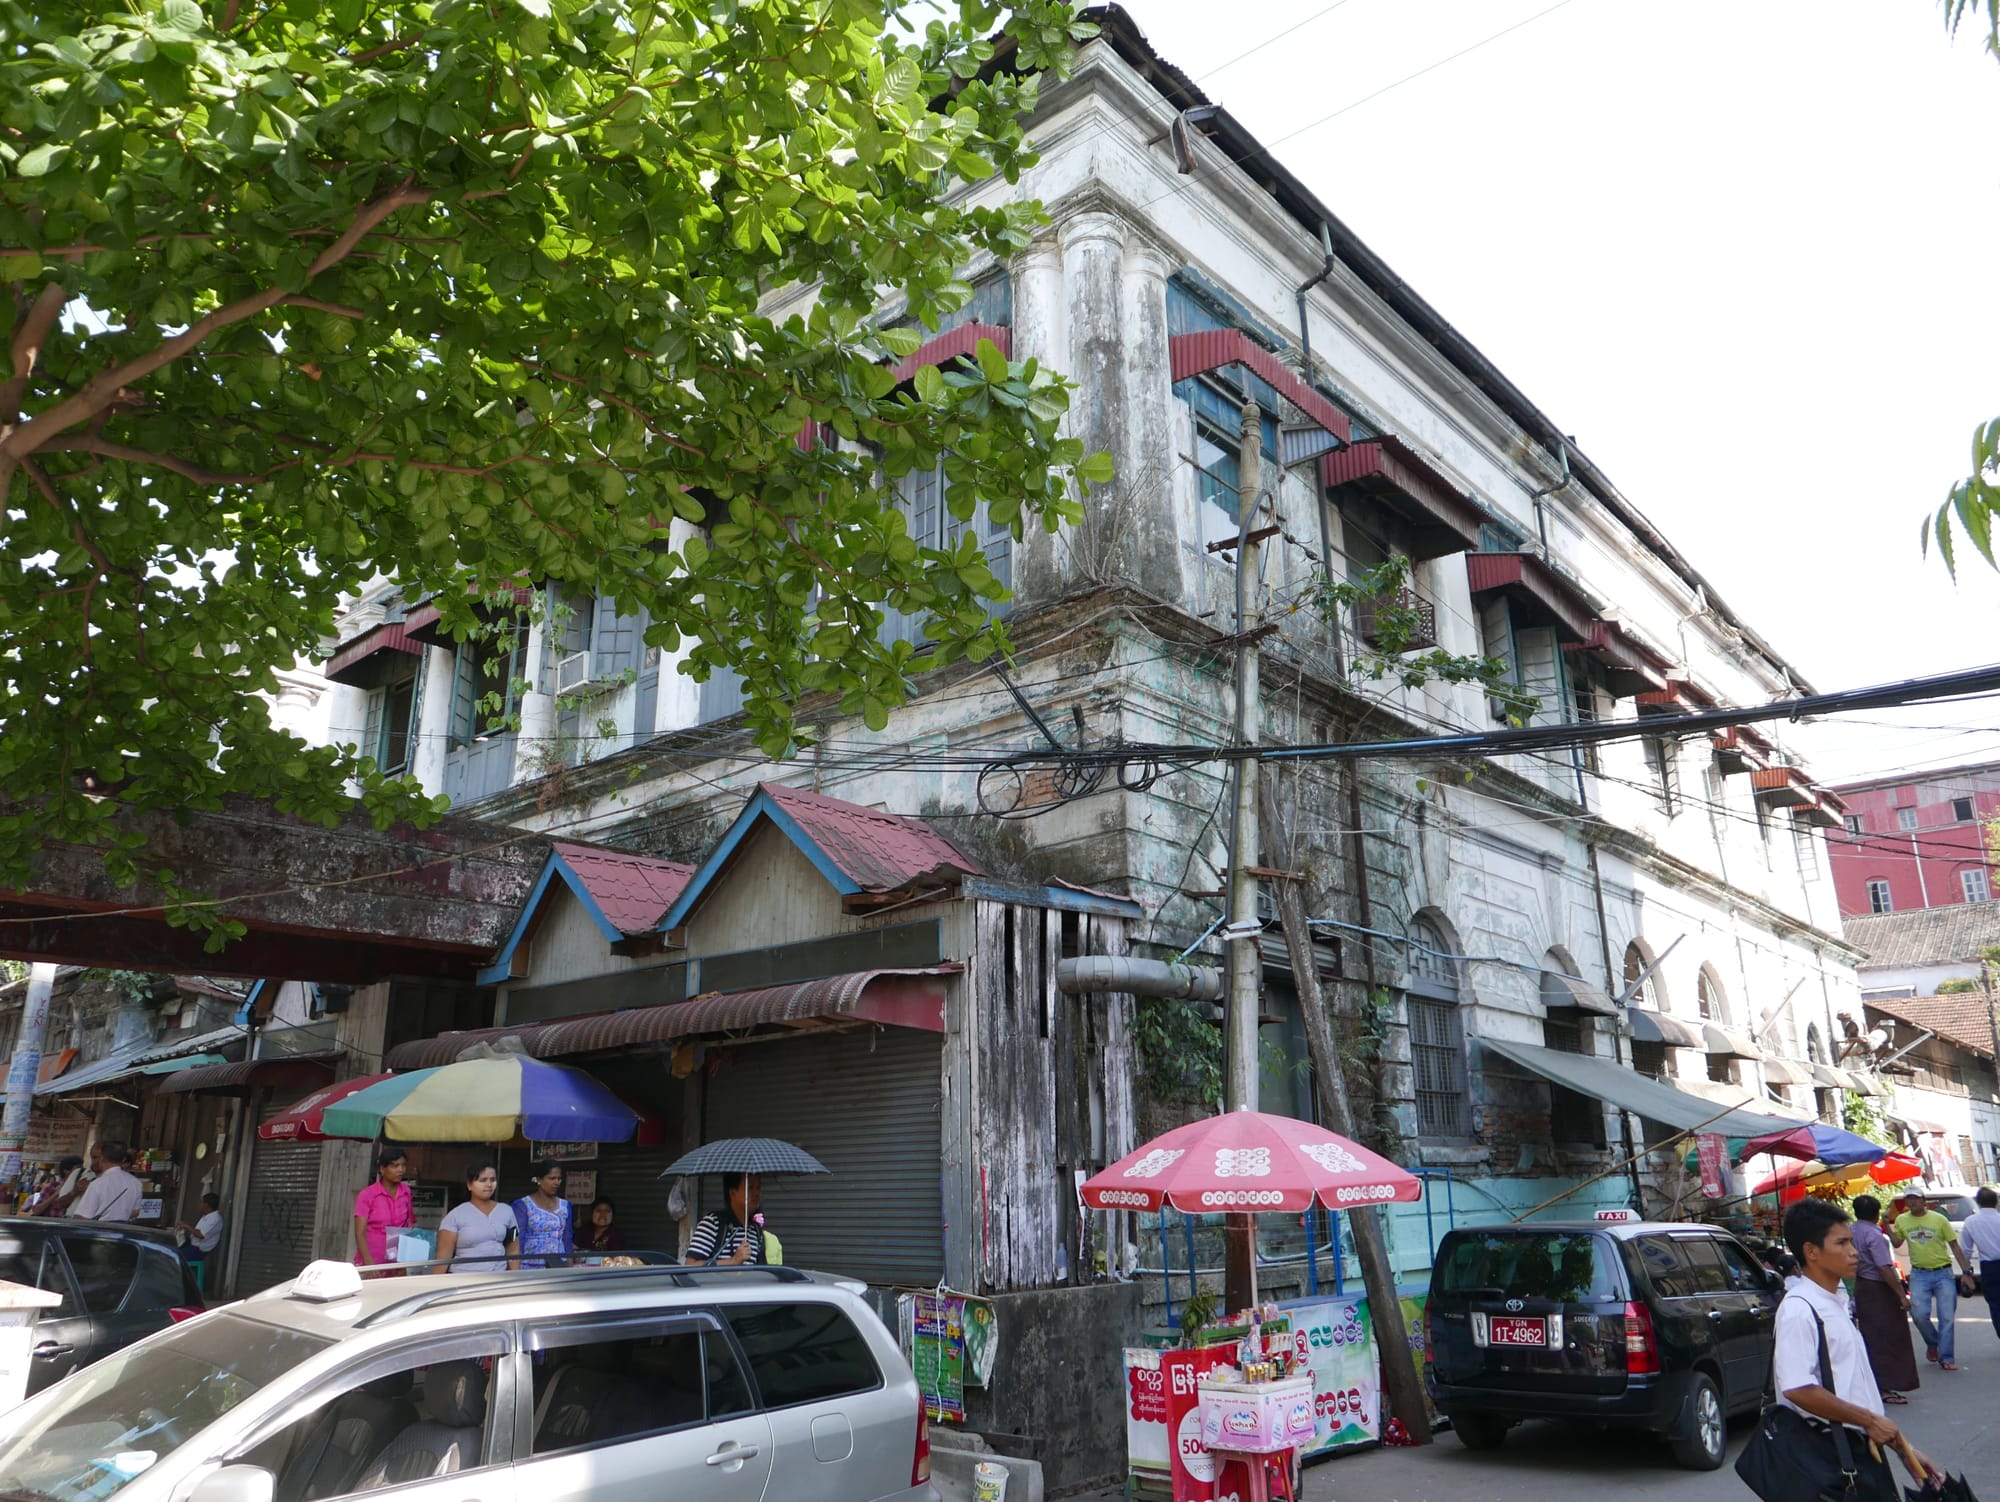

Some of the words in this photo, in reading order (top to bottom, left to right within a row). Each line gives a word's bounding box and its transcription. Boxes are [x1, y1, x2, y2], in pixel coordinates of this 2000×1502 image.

[1100, 1190, 1149, 1206] ooredoo
[1202, 1191, 1284, 1206] ooredoo
[1337, 1185, 1395, 1202] ooredoo
[1599, 1211, 1627, 1220] TAXI
[1495, 1327, 1542, 1343] 1I-4962
